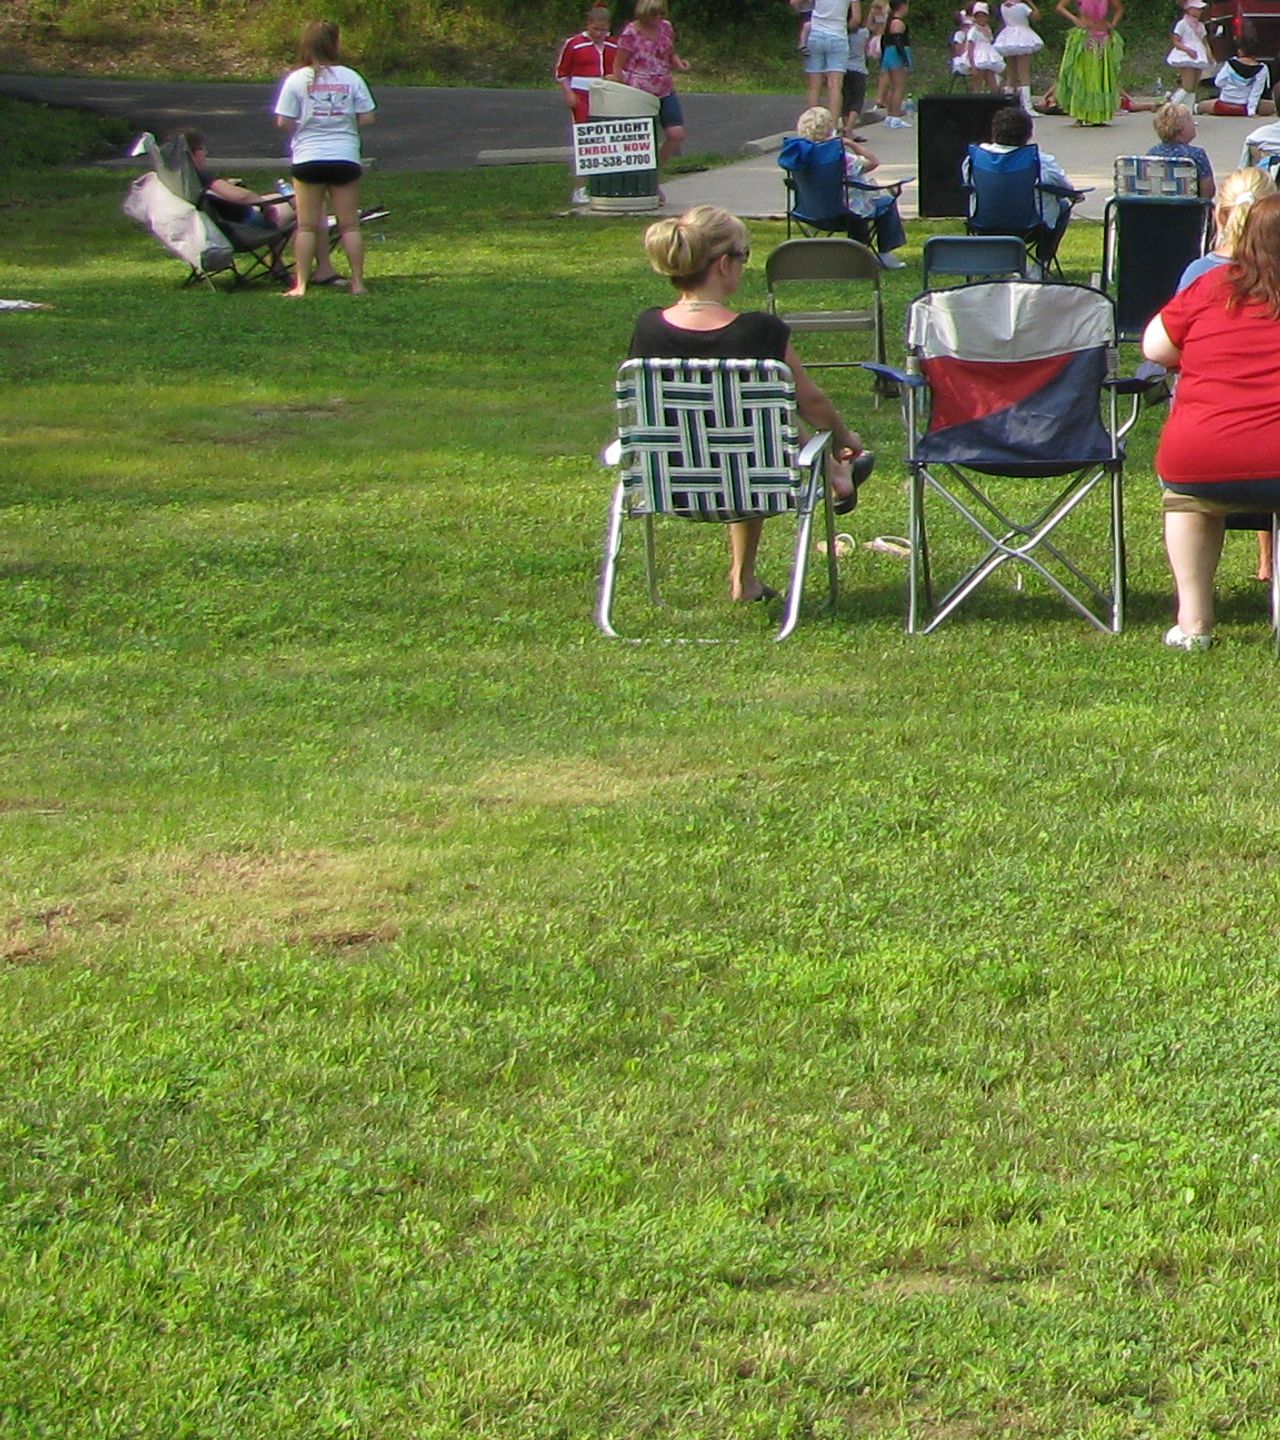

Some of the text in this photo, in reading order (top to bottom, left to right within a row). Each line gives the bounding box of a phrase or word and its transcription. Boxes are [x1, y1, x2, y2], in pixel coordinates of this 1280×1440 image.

[577, 122, 650, 137] SPOTLIGHT
[577, 133, 651, 146] DANCE ACADEMY
[578, 142, 651, 157] ENROLL NOW
[579, 154, 651, 170] 330-538-0700
